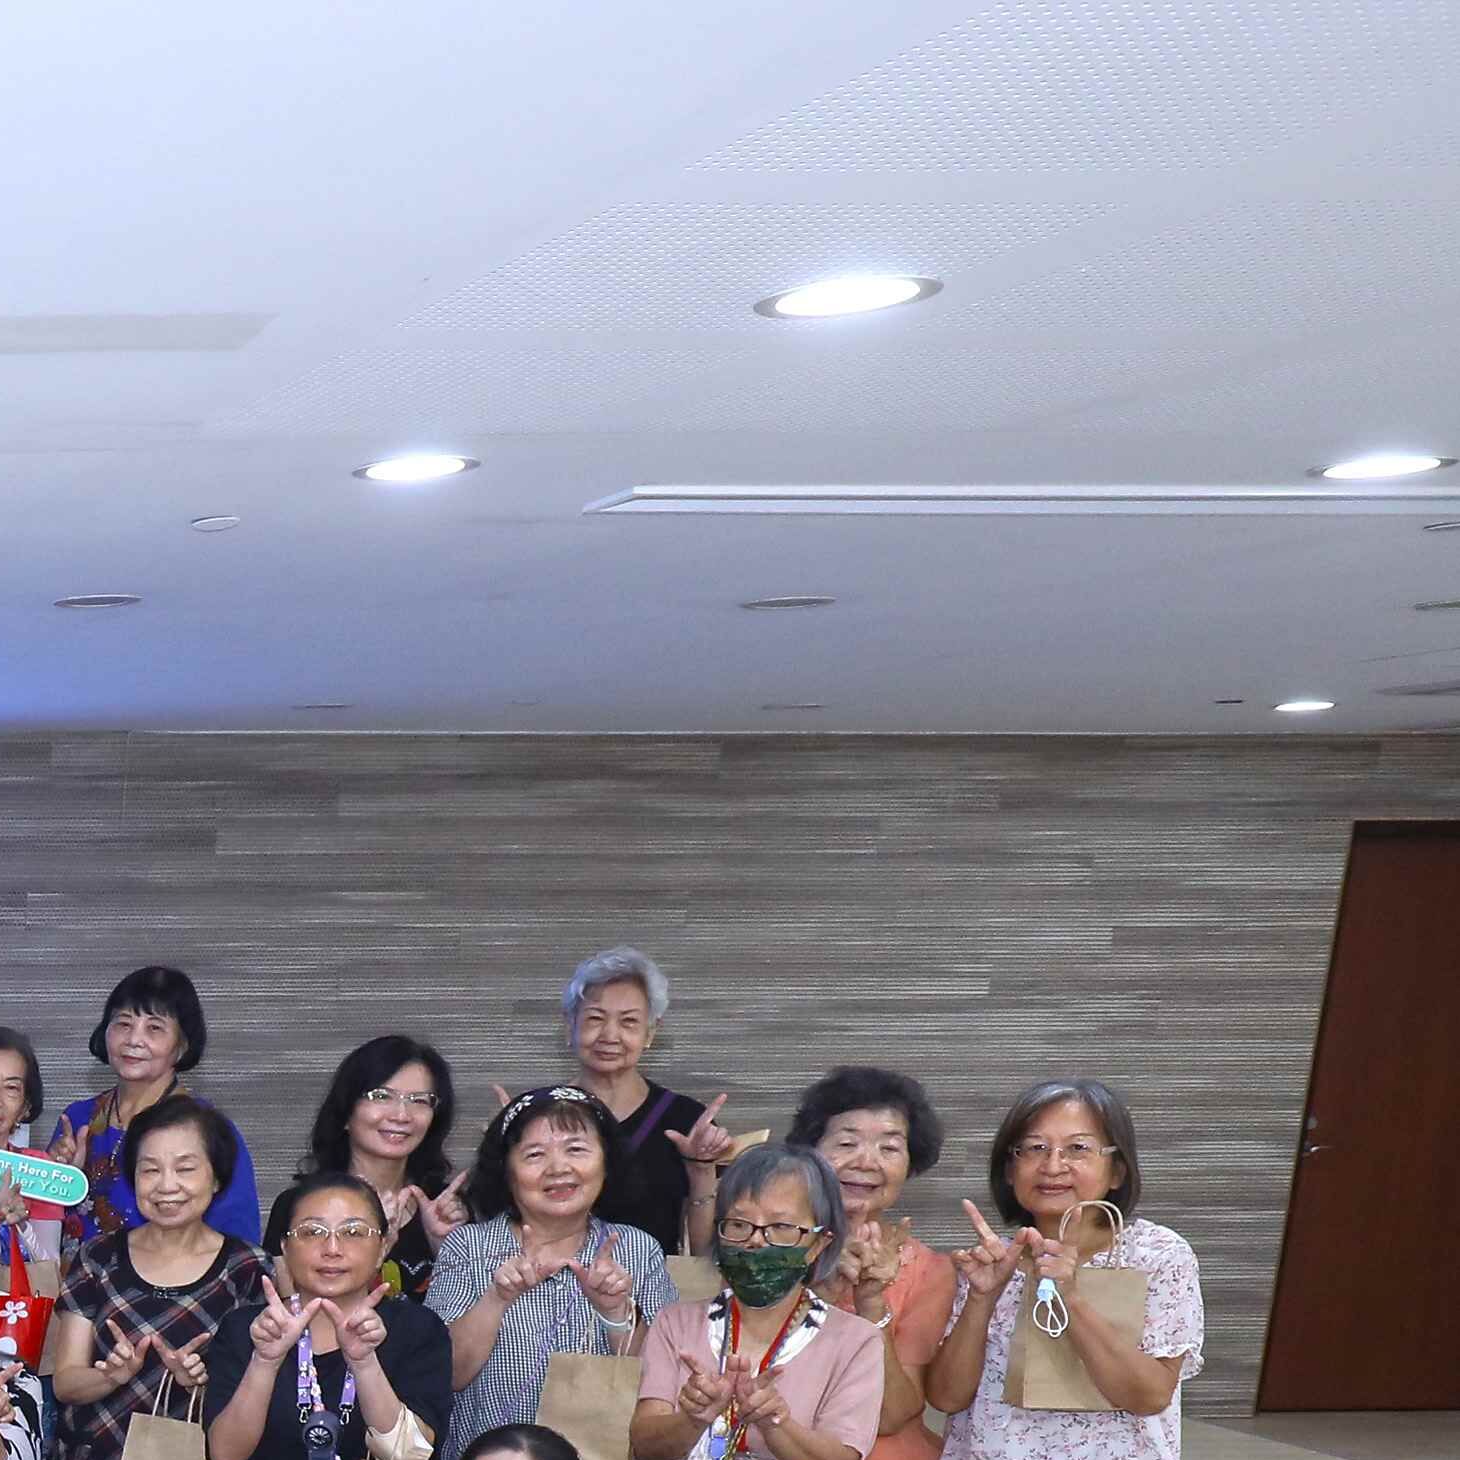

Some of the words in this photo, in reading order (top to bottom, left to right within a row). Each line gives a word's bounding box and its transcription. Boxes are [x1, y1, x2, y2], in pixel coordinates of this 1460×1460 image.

[17, 1161, 48, 1179] Here
[51, 1169, 74, 1184] For
[39, 1180, 71, 1198] You.
